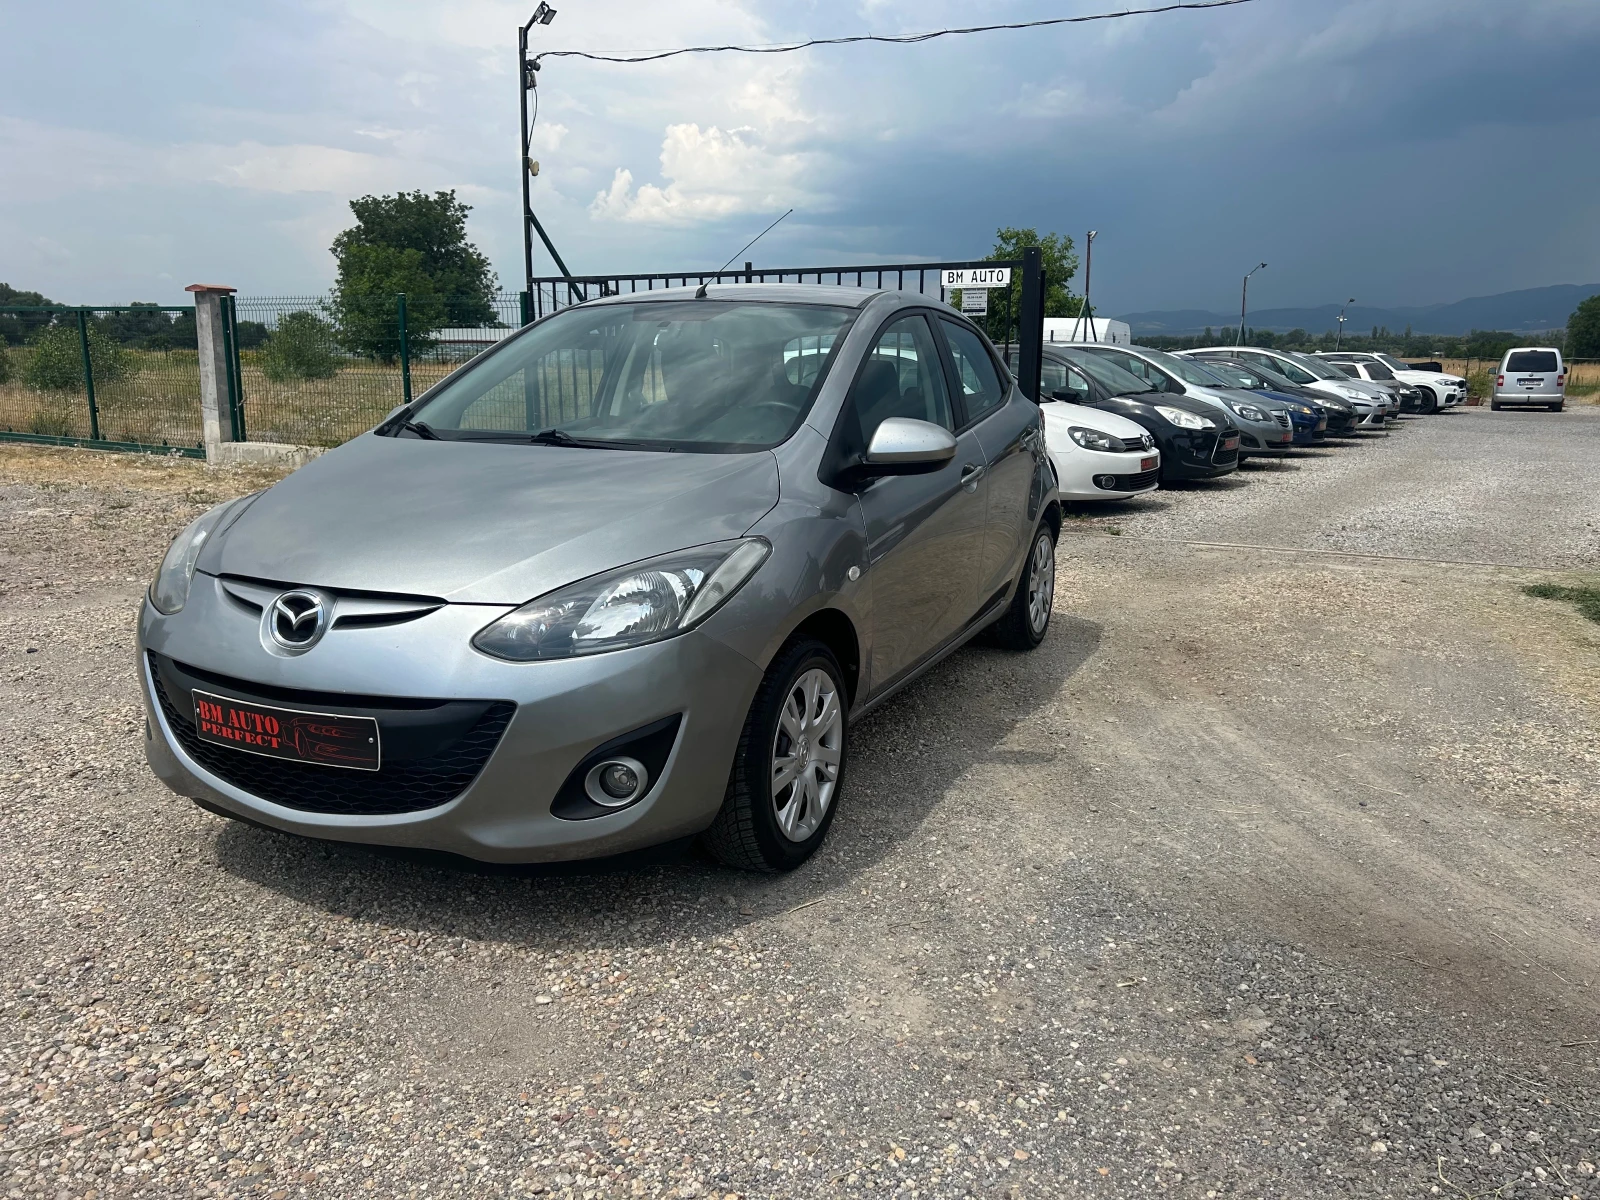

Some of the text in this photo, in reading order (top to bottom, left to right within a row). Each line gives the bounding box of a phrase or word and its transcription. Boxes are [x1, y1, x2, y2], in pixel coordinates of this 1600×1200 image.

[947, 270, 1004, 283] BM AUTO
[199, 700, 280, 735] BM AUTO
[201, 721, 281, 749] PERFECT
